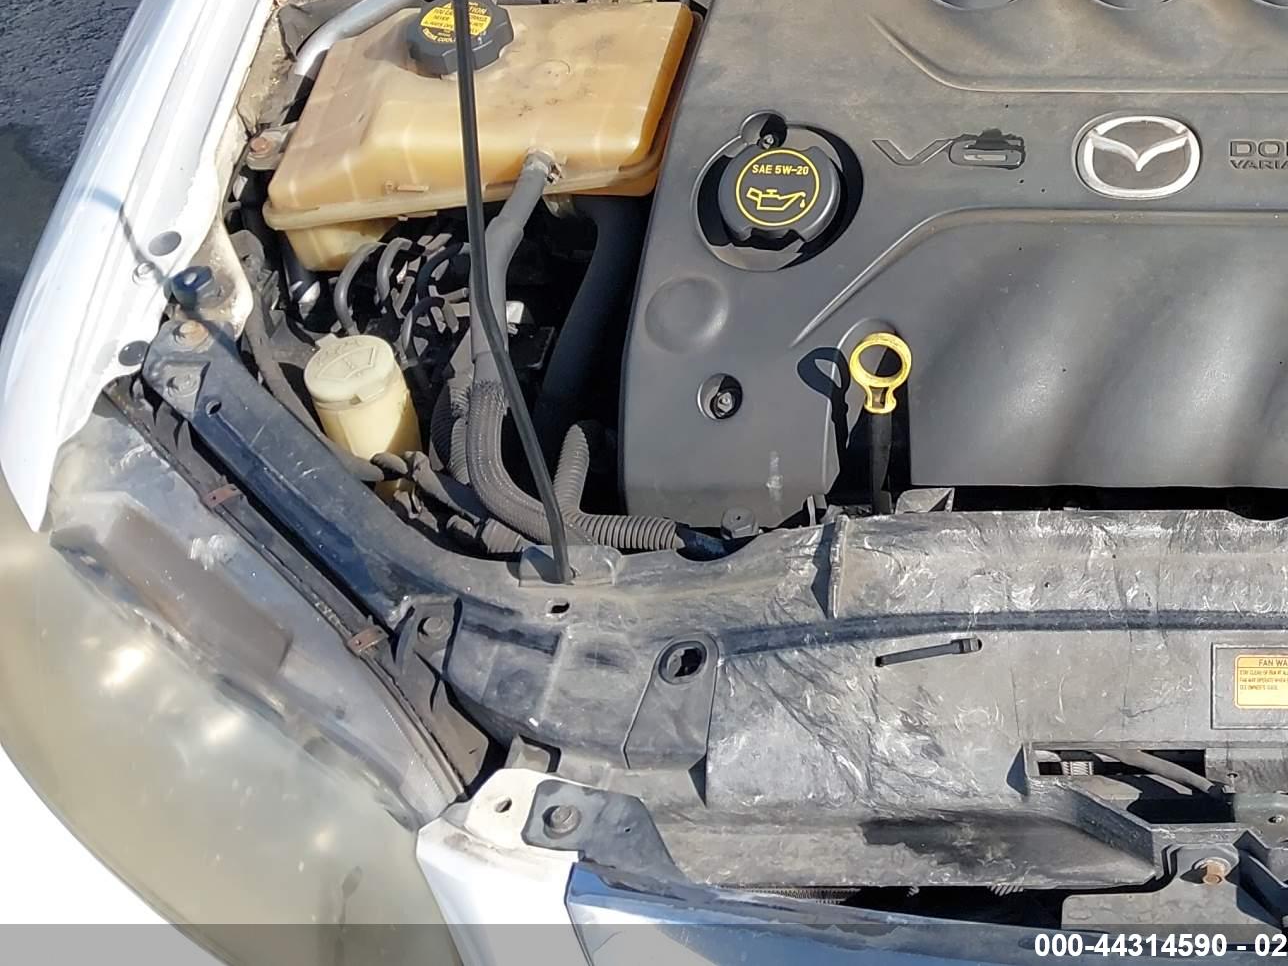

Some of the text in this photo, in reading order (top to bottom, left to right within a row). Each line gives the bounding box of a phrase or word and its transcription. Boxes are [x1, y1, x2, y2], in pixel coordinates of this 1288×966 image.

[751, 163, 809, 176] SAE 5W-20
[1258, 658, 1274, 667] FAN
